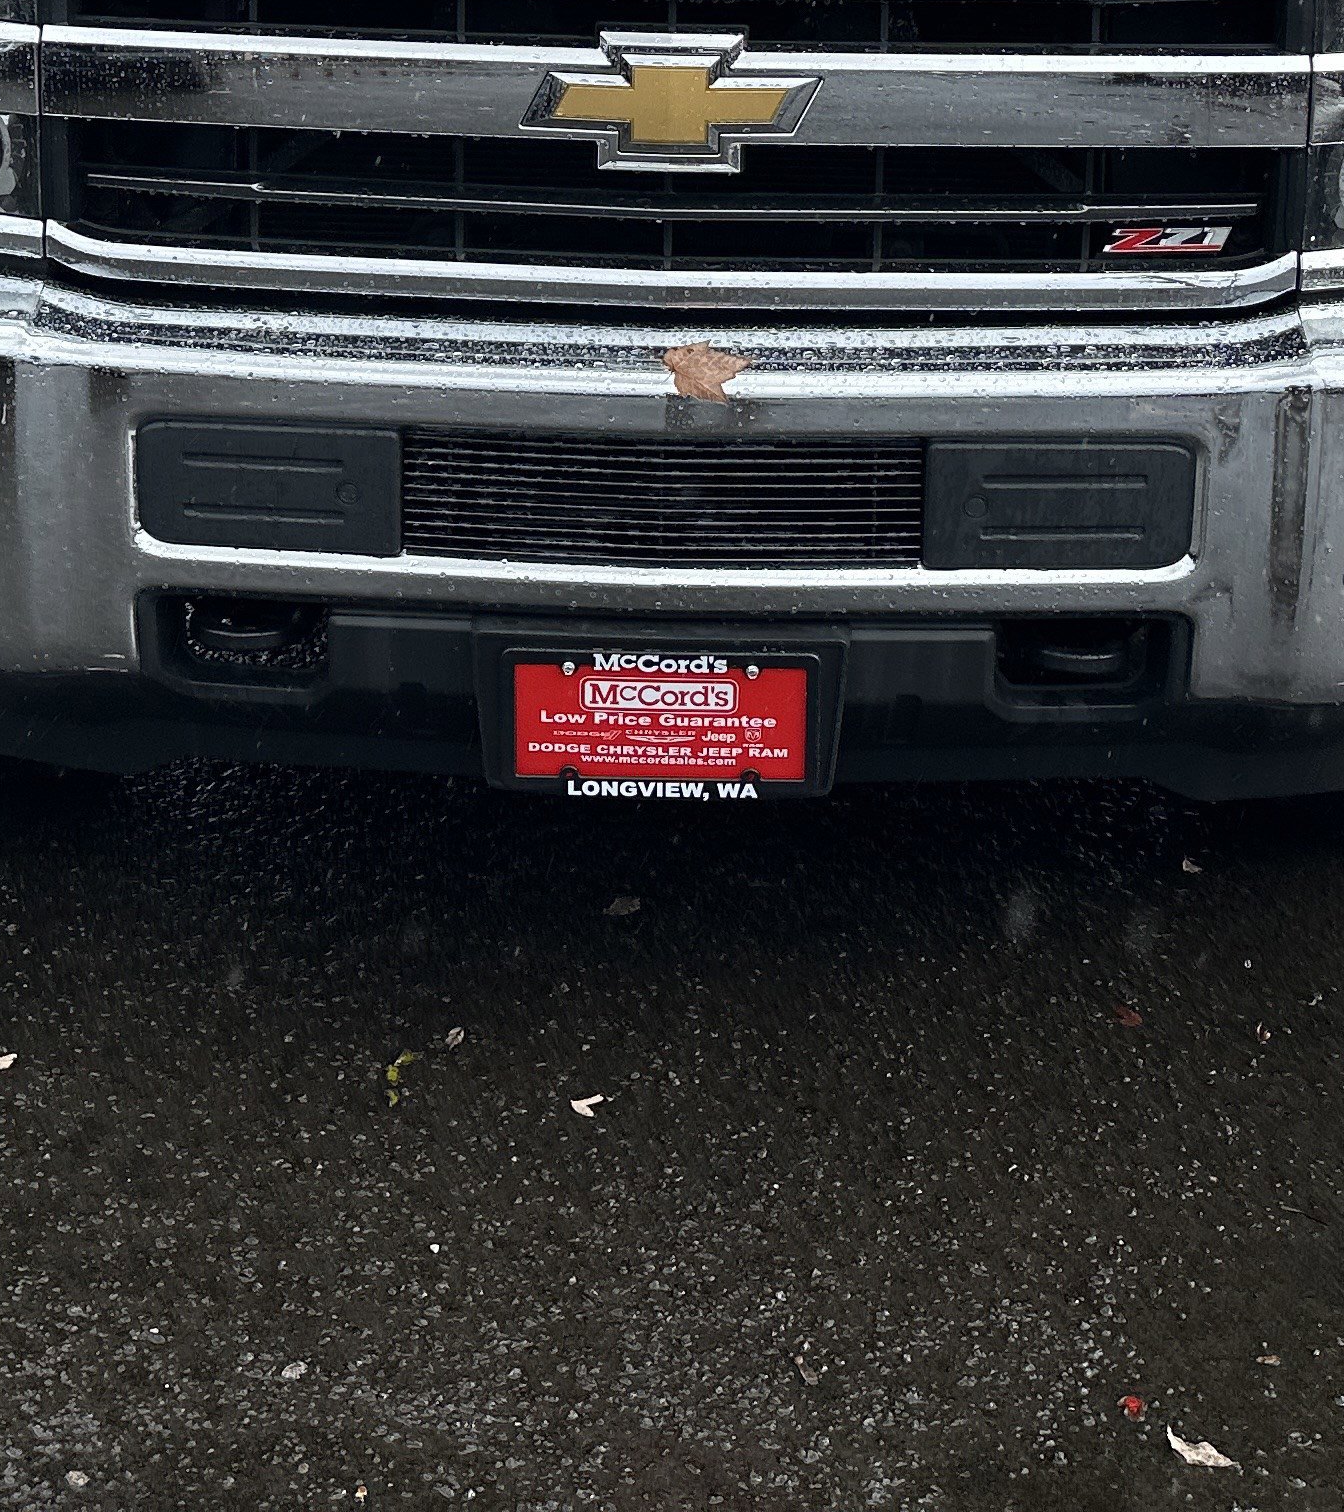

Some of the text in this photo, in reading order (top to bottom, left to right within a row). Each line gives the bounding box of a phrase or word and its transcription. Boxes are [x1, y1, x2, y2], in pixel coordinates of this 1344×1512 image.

[1102, 226, 1233, 253] Z71
[592, 653, 728, 674] McCord's
[589, 683, 729, 707] McCord's
[540, 710, 777, 728] Low Price Guarantee
[701, 731, 736, 743] Jeep
[528, 742, 789, 758] DODGE CHRYSLER JEEP RAM
[580, 754, 736, 766] www.mccordsales.com
[567, 780, 758, 801] LONGVIEW, WA
